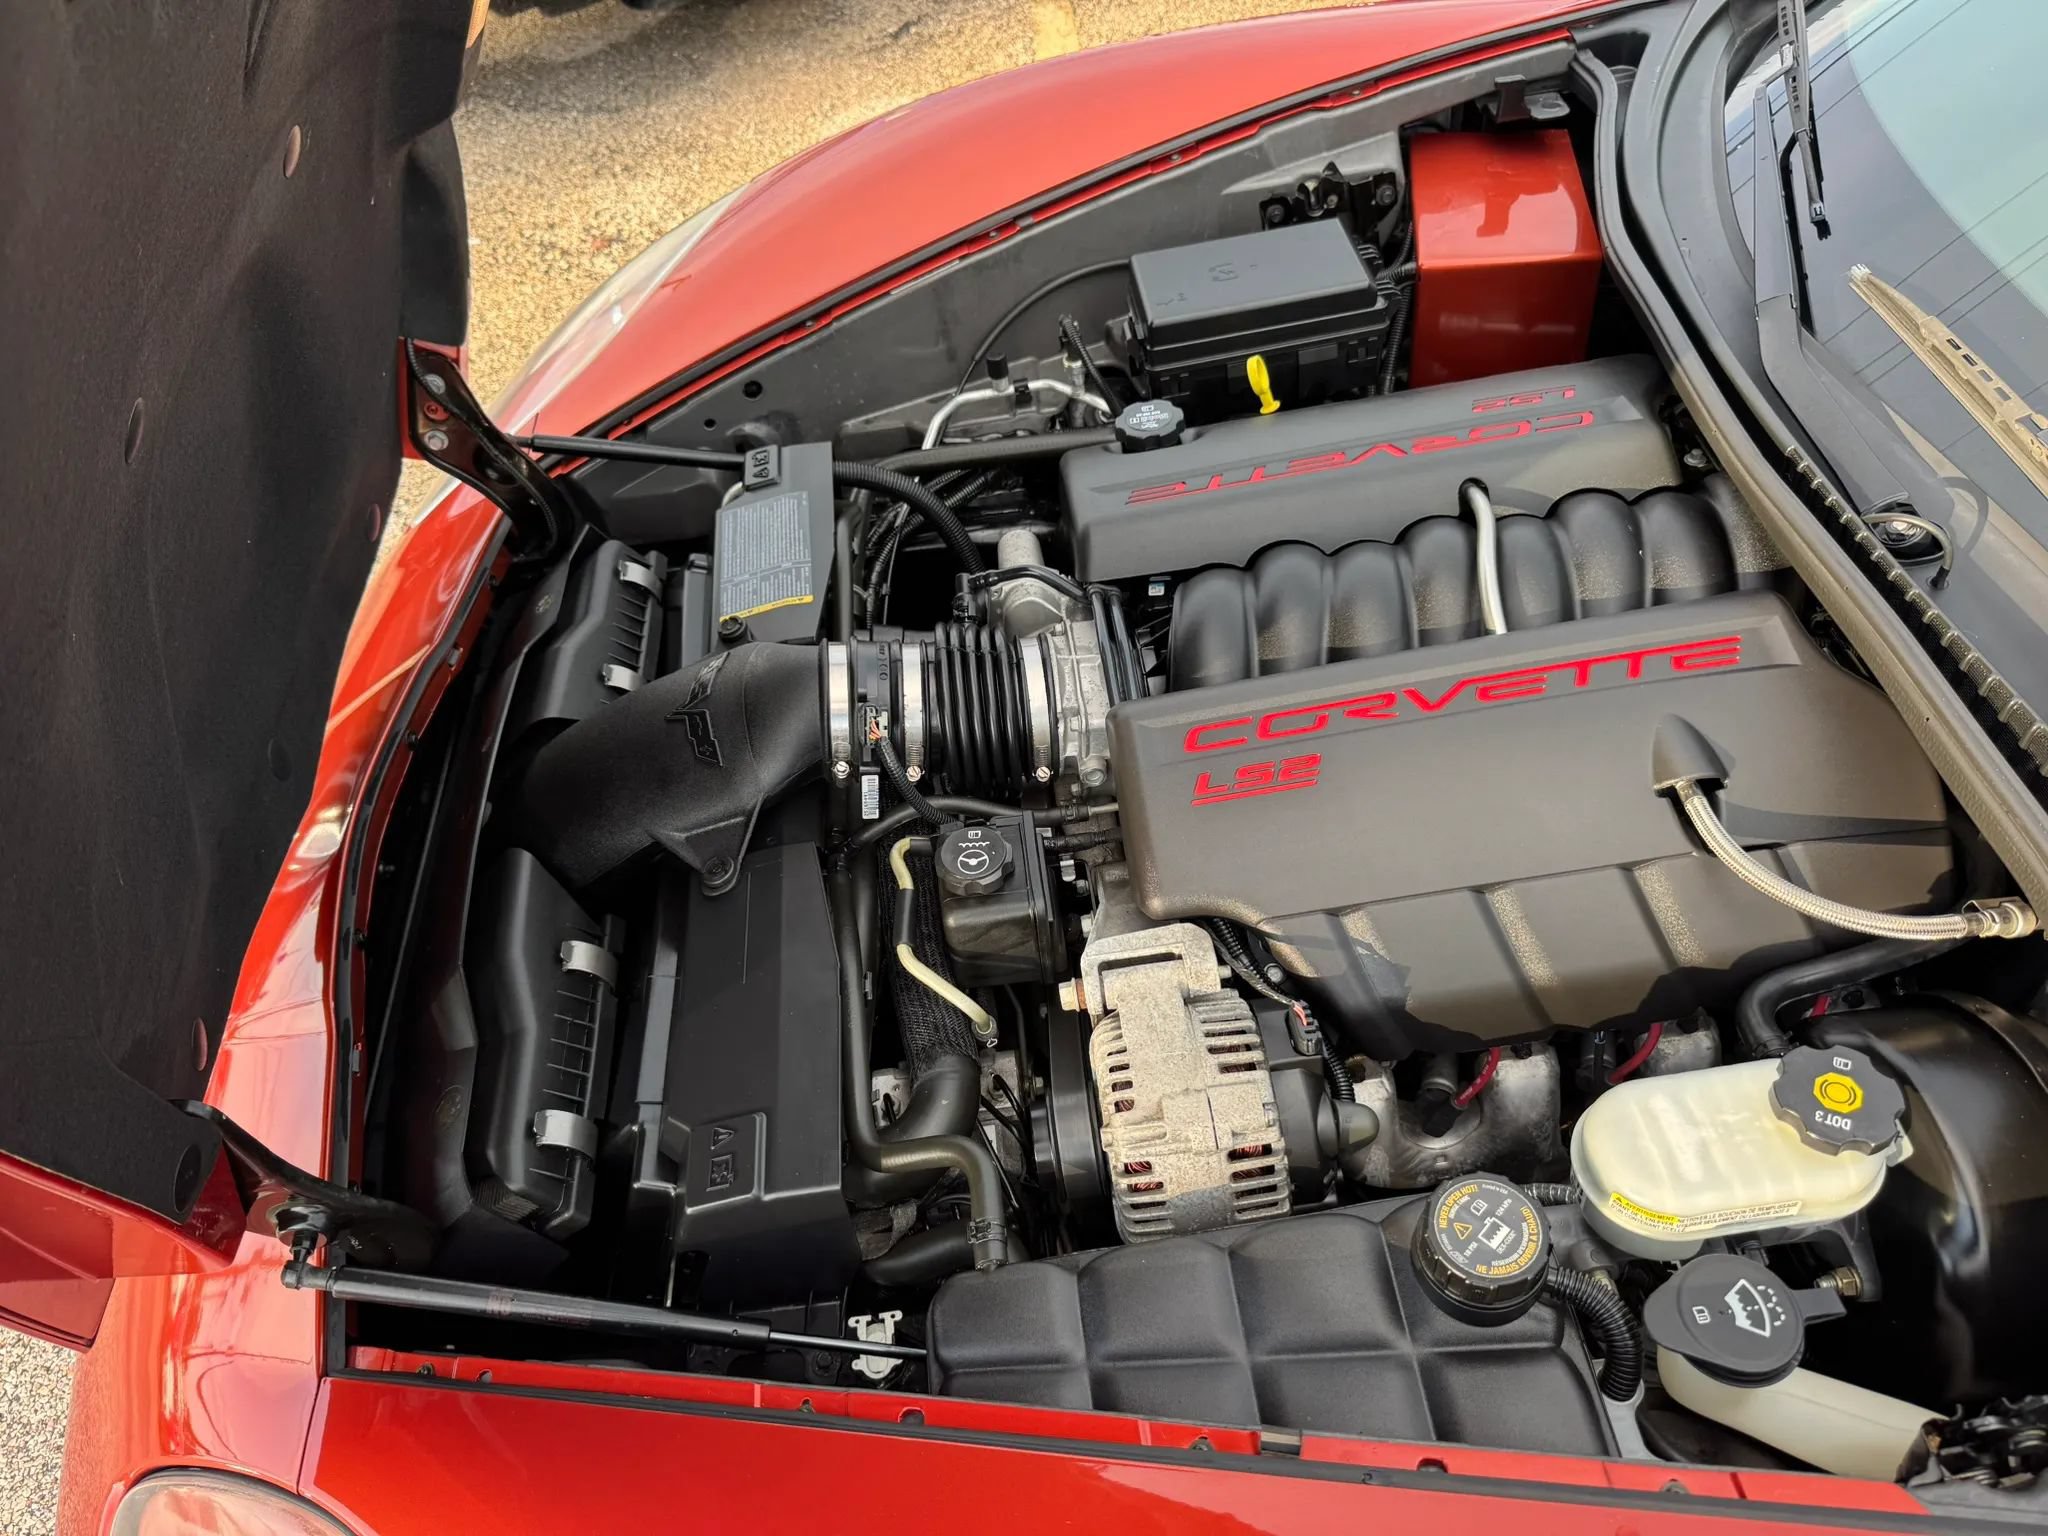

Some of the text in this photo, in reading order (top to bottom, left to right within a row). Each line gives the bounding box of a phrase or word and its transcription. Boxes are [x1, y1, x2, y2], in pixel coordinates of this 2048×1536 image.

[1472, 387, 1576, 412] LS2
[1128, 410, 1594, 504] CORVETTE
[1184, 635, 1741, 752] CORVETTE
[1193, 753, 1321, 799] LS2
[1814, 1110, 1852, 1131] DOT 3
[1439, 1205, 1449, 1228] NEVER
[1445, 1190, 1463, 1207] OPEN
[1460, 1184, 1479, 1196] HOT!
[1520, 1206, 1537, 1234] CHAUD!
[1517, 1241, 1537, 1266] OUVRIR
[1475, 1264, 1488, 1274] NE
[1489, 1262, 1520, 1275] JAMAIS
